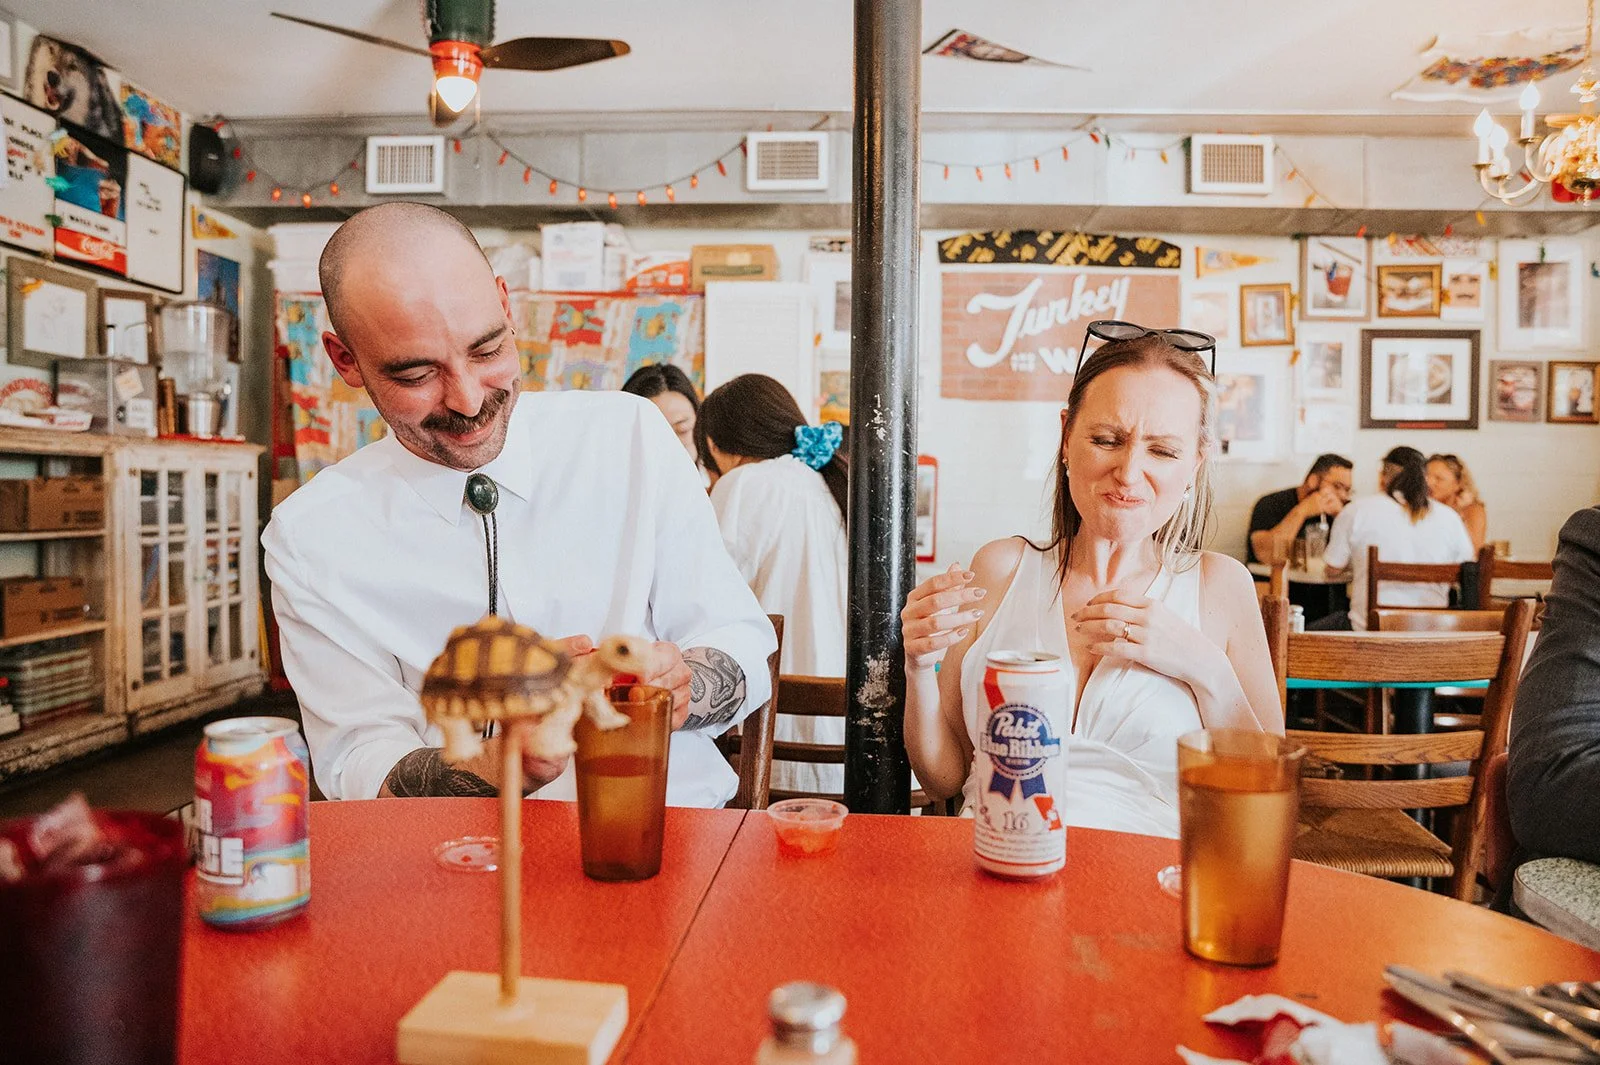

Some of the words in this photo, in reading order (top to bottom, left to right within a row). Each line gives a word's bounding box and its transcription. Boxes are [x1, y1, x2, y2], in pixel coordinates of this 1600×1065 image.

[966, 274, 1130, 369] Turkey
[994, 711, 1042, 739] Pabst
[1009, 738, 1059, 758] Ribb
[1003, 810, 1029, 831] 16
